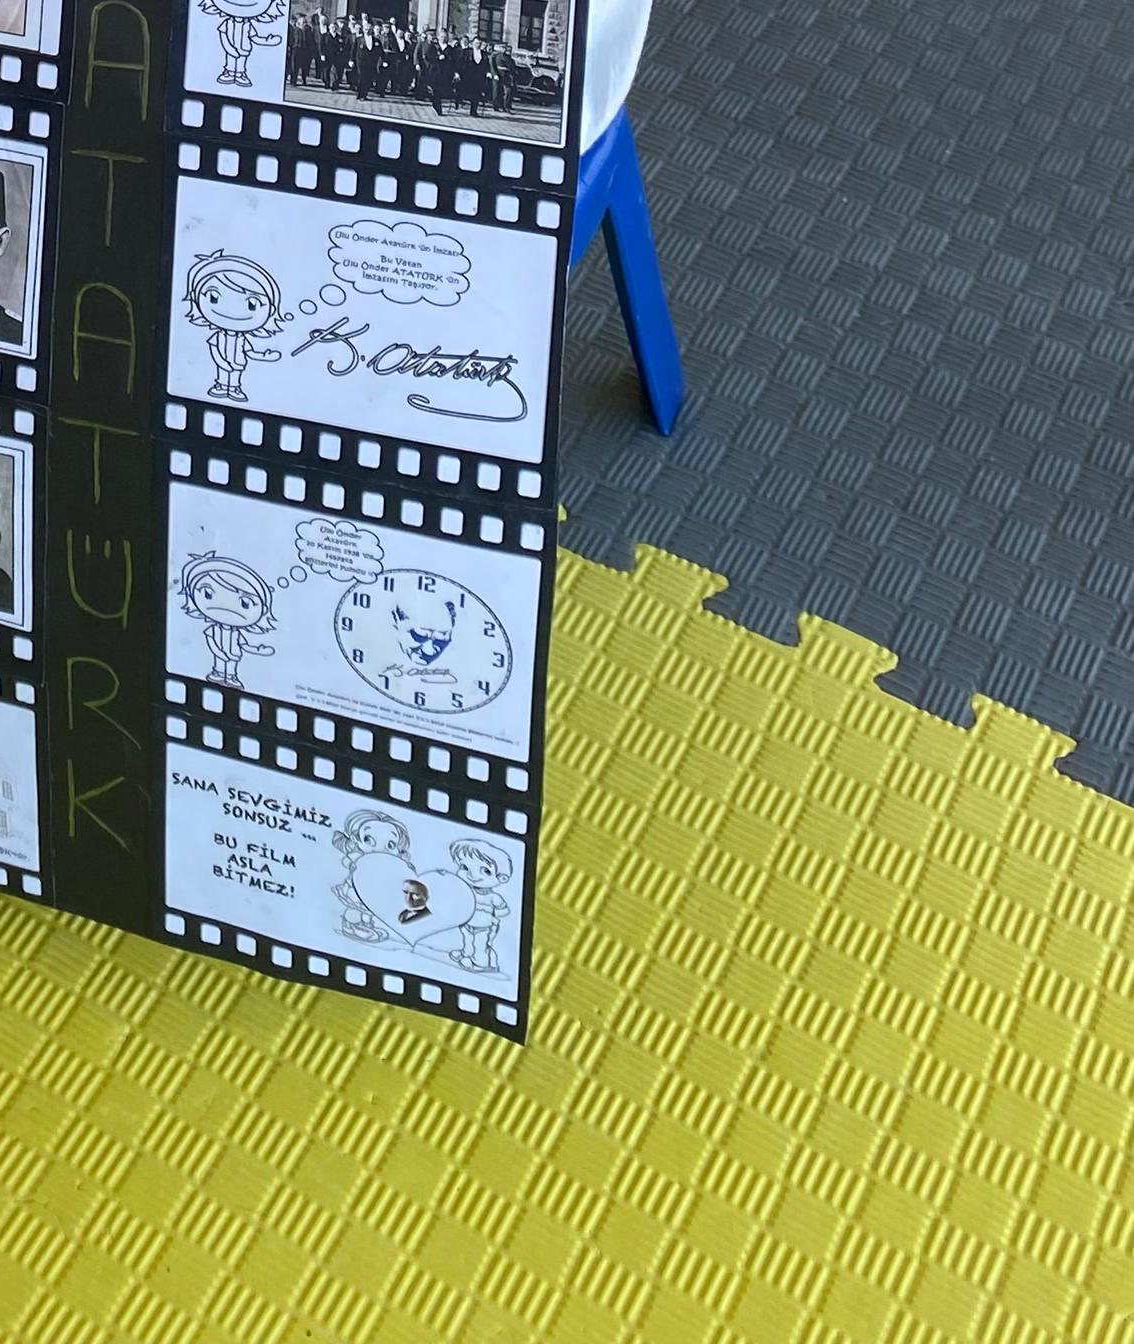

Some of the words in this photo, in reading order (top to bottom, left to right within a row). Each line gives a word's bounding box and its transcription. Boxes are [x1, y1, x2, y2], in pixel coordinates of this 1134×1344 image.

[379, 254, 393, 264] Bu
[394, 257, 423, 269] Vatan
[383, 575, 395, 593] 11
[417, 574, 437, 593] 12
[352, 591, 372, 609] 10
[459, 592, 466, 609] 1
[341, 616, 354, 632] 9
[482, 620, 497, 638] 2
[351, 648, 365, 664] 8
[491, 650, 506, 669] 3
[377, 673, 390, 690] 7
[477, 679, 491, 697] 4
[413, 690, 427, 707] 6
[450, 692, 465, 709] 5
[171, 771, 220, 797] SANA
[227, 786, 333, 829] SEVGİMİZ
[222, 802, 293, 833] SONSUZ
[213, 832, 239, 850] BU
[246, 842, 297, 869] FİLM
[227, 852, 274, 878] ASLA
[212, 864, 296, 899] BİTMEZ!
